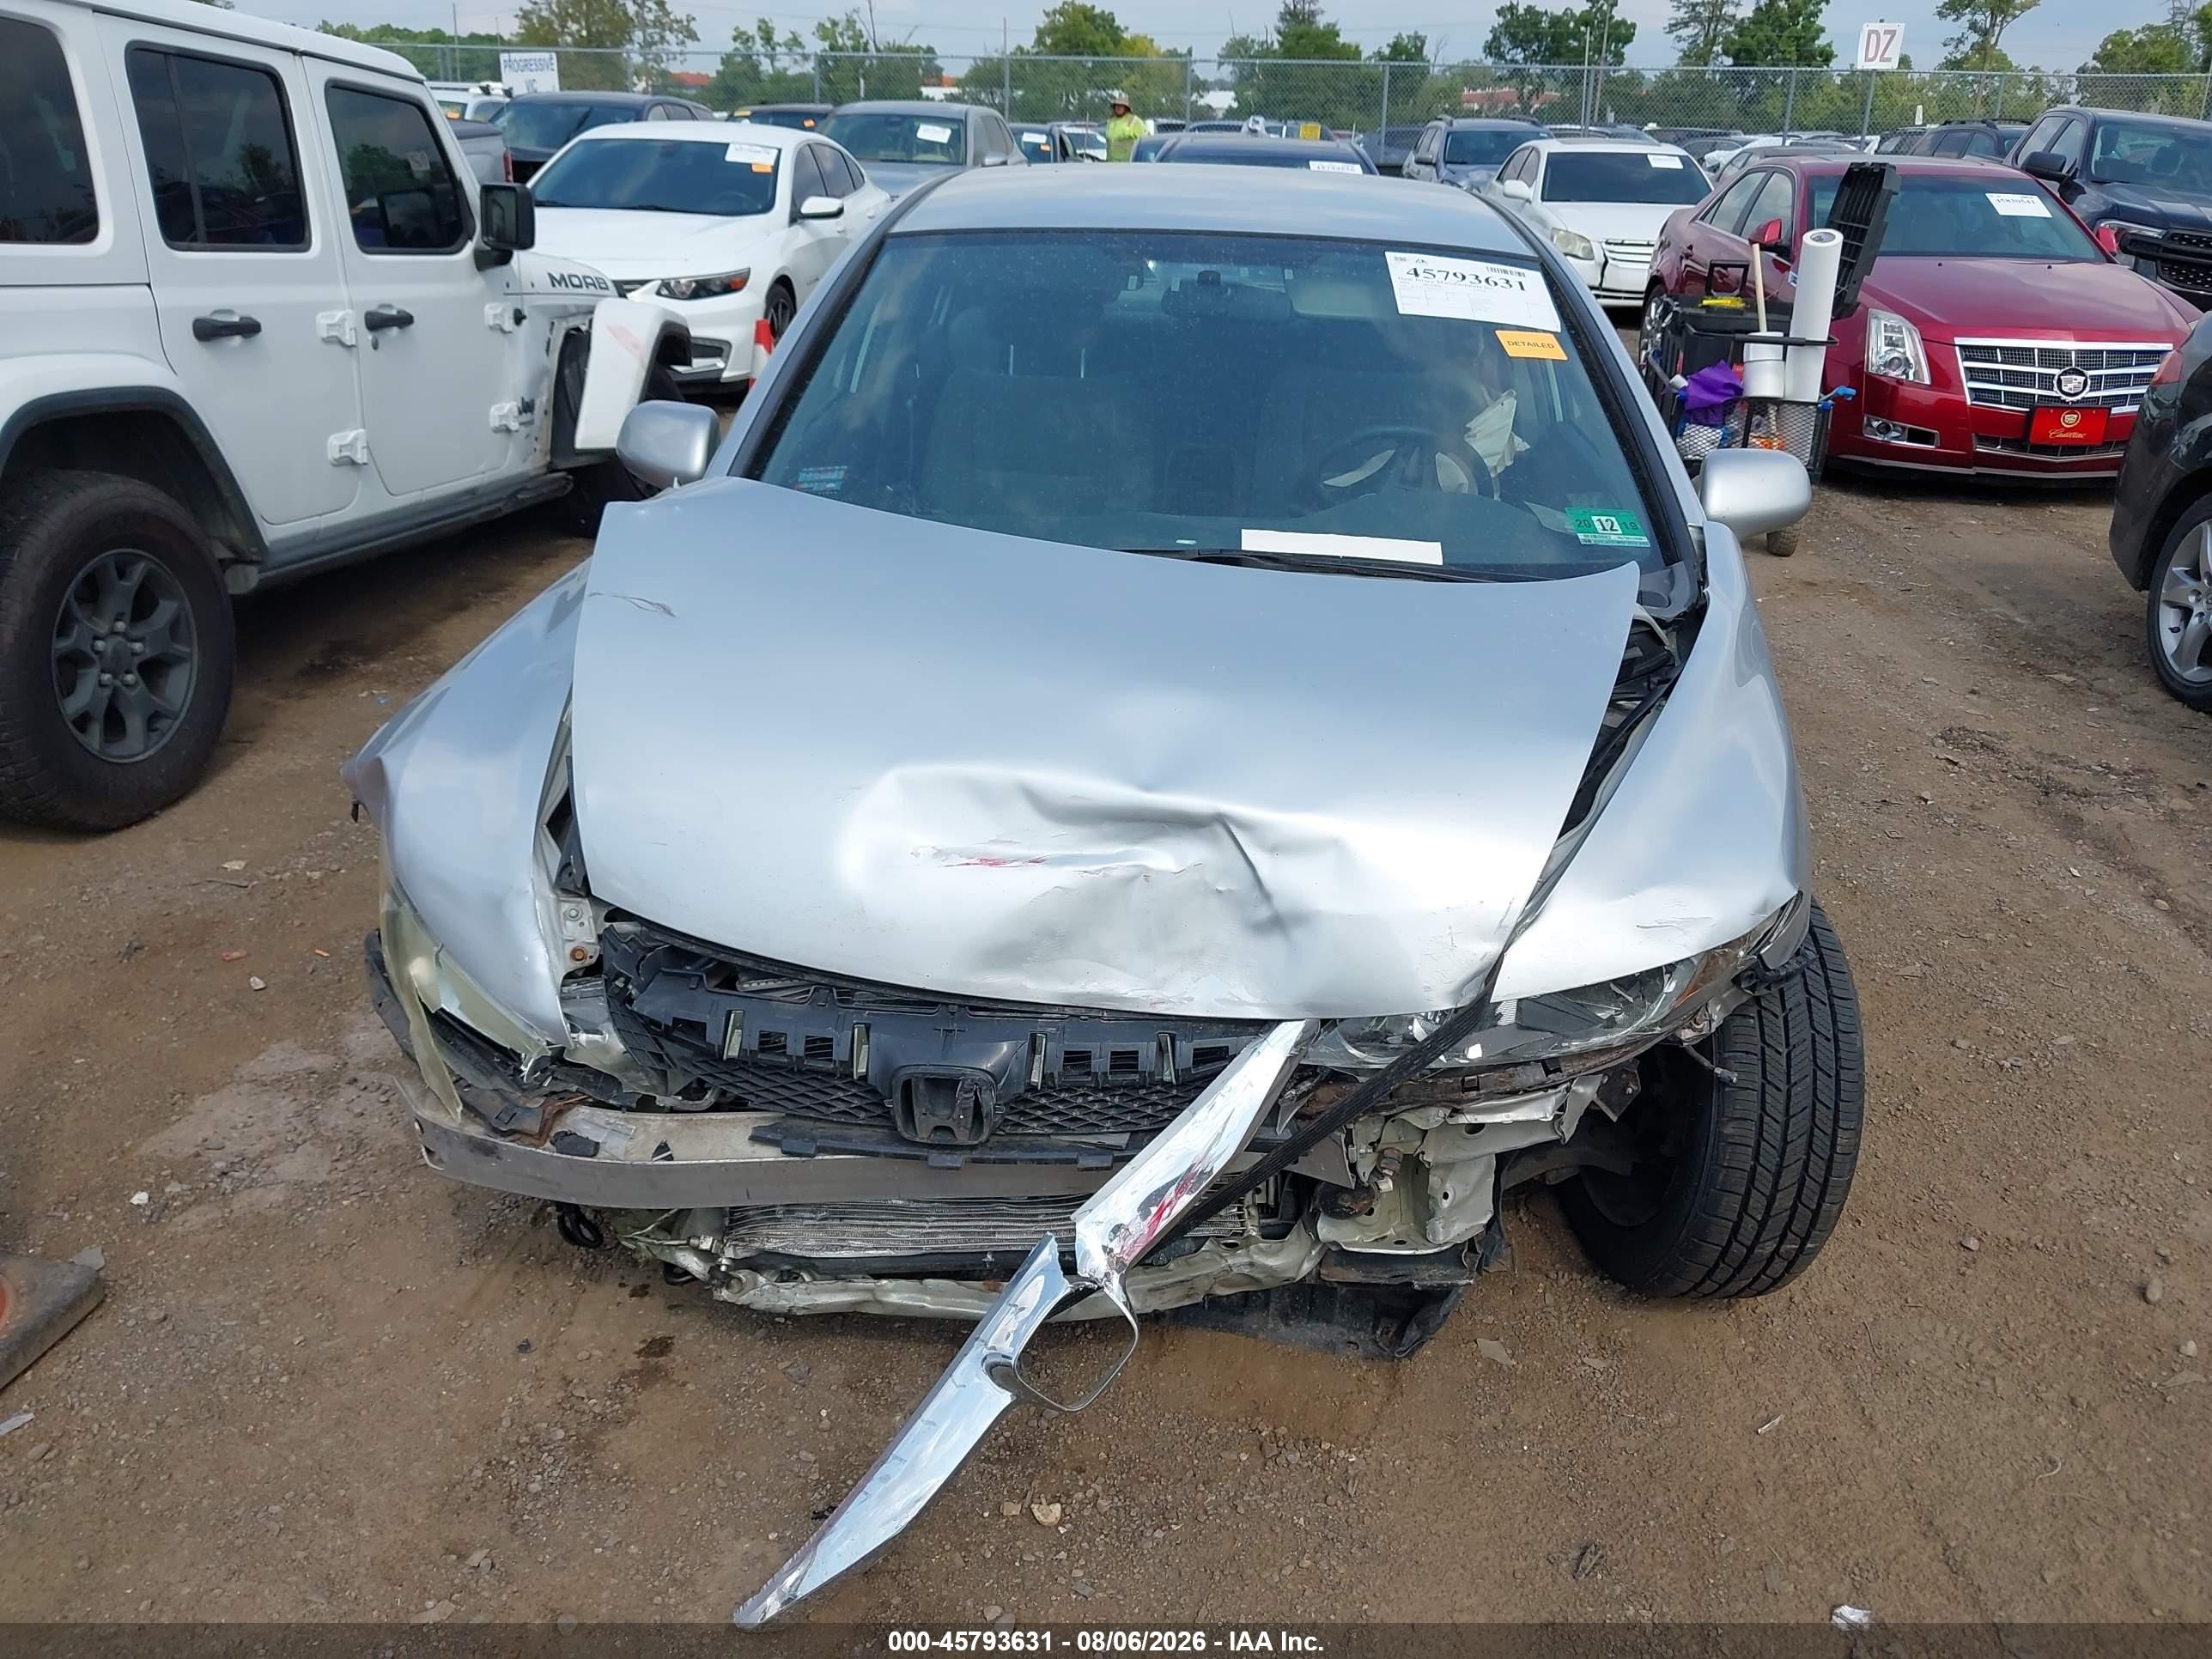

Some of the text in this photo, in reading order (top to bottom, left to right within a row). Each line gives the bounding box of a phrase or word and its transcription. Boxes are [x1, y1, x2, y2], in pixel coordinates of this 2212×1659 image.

[1864, 29, 1897, 63] DZ
[503, 58, 555, 73] PROGRESSIVE
[547, 272, 610, 291] MOAB
[1406, 267, 1527, 292] 45793631
[1506, 340, 1555, 349] DETAILED
[1575, 519, 1638, 532] 20 12 19
